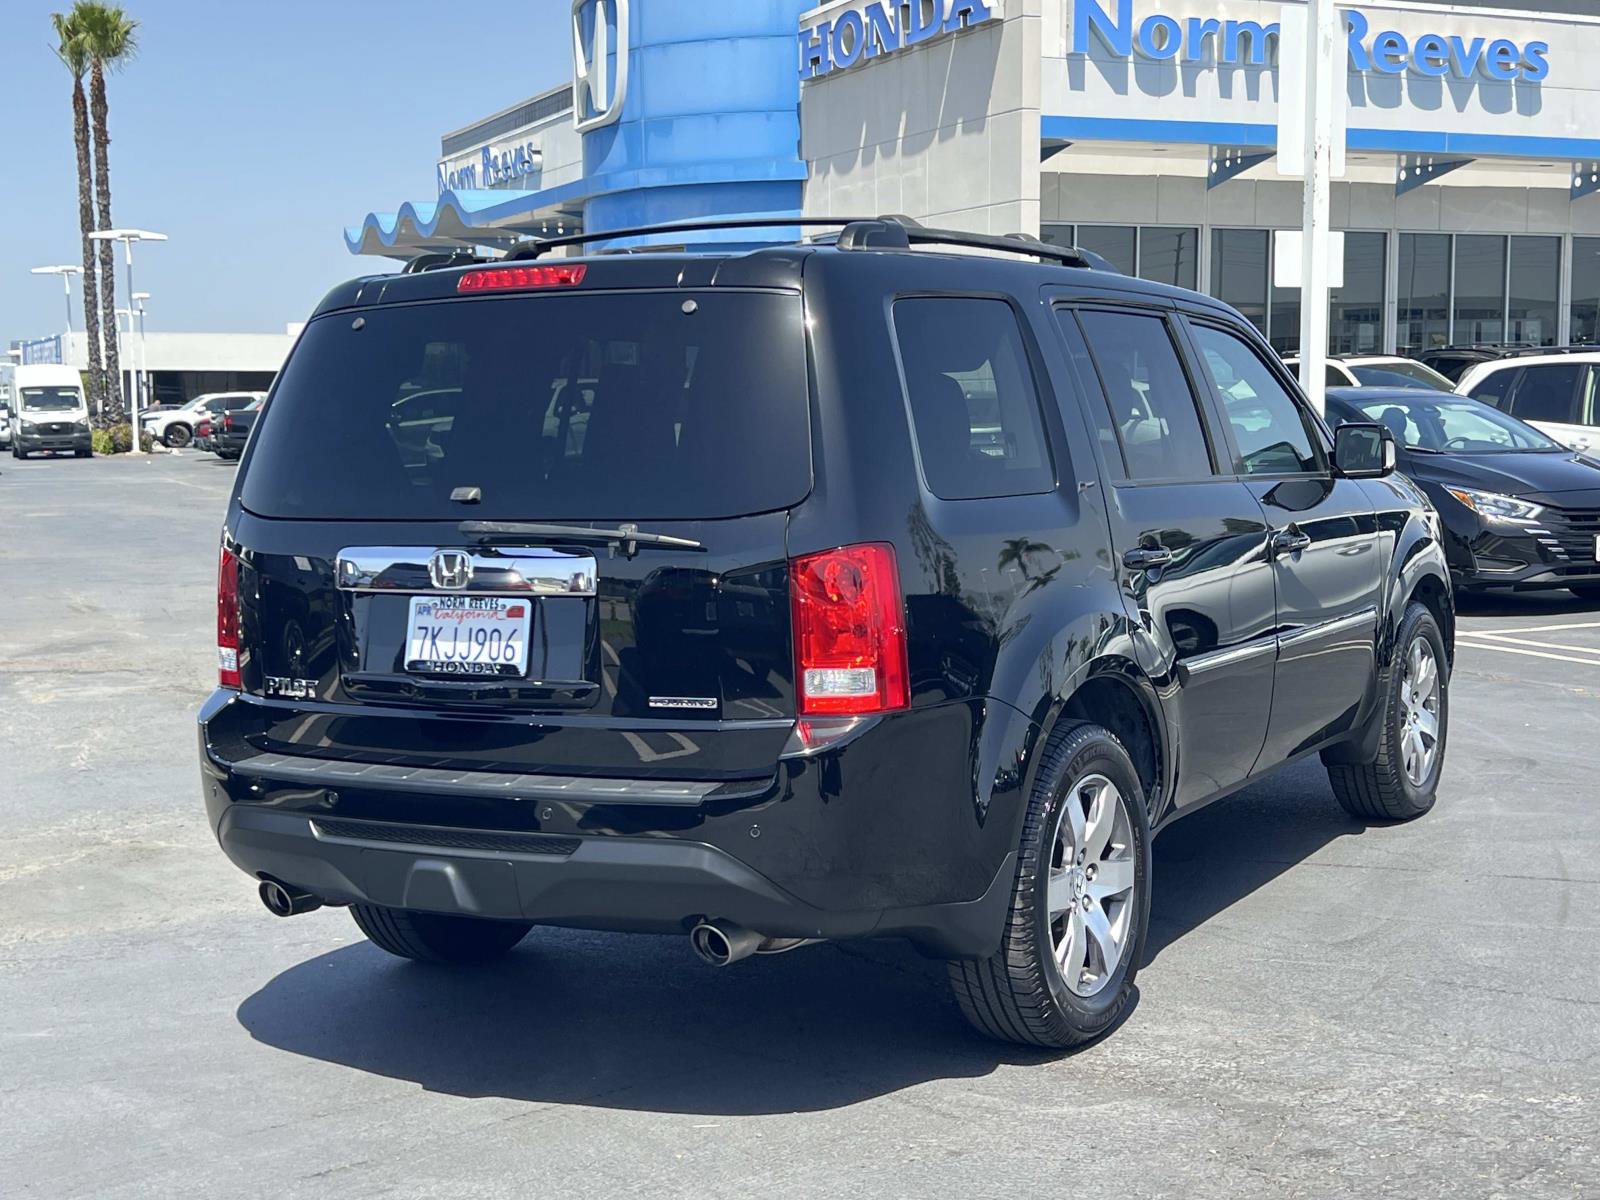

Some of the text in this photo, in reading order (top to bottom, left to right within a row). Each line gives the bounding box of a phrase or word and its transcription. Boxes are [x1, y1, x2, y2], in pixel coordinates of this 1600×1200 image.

[799, 0, 991, 81] HONDA
[1073, 0, 1280, 64] Norm
[438, 142, 534, 195] Norm Reeves
[417, 606, 431, 616] APR
[434, 610, 506, 622] California
[440, 597, 499, 611] NORM REEVES
[418, 626, 518, 662] 7KJJ906
[434, 661, 499, 674] HONDA
